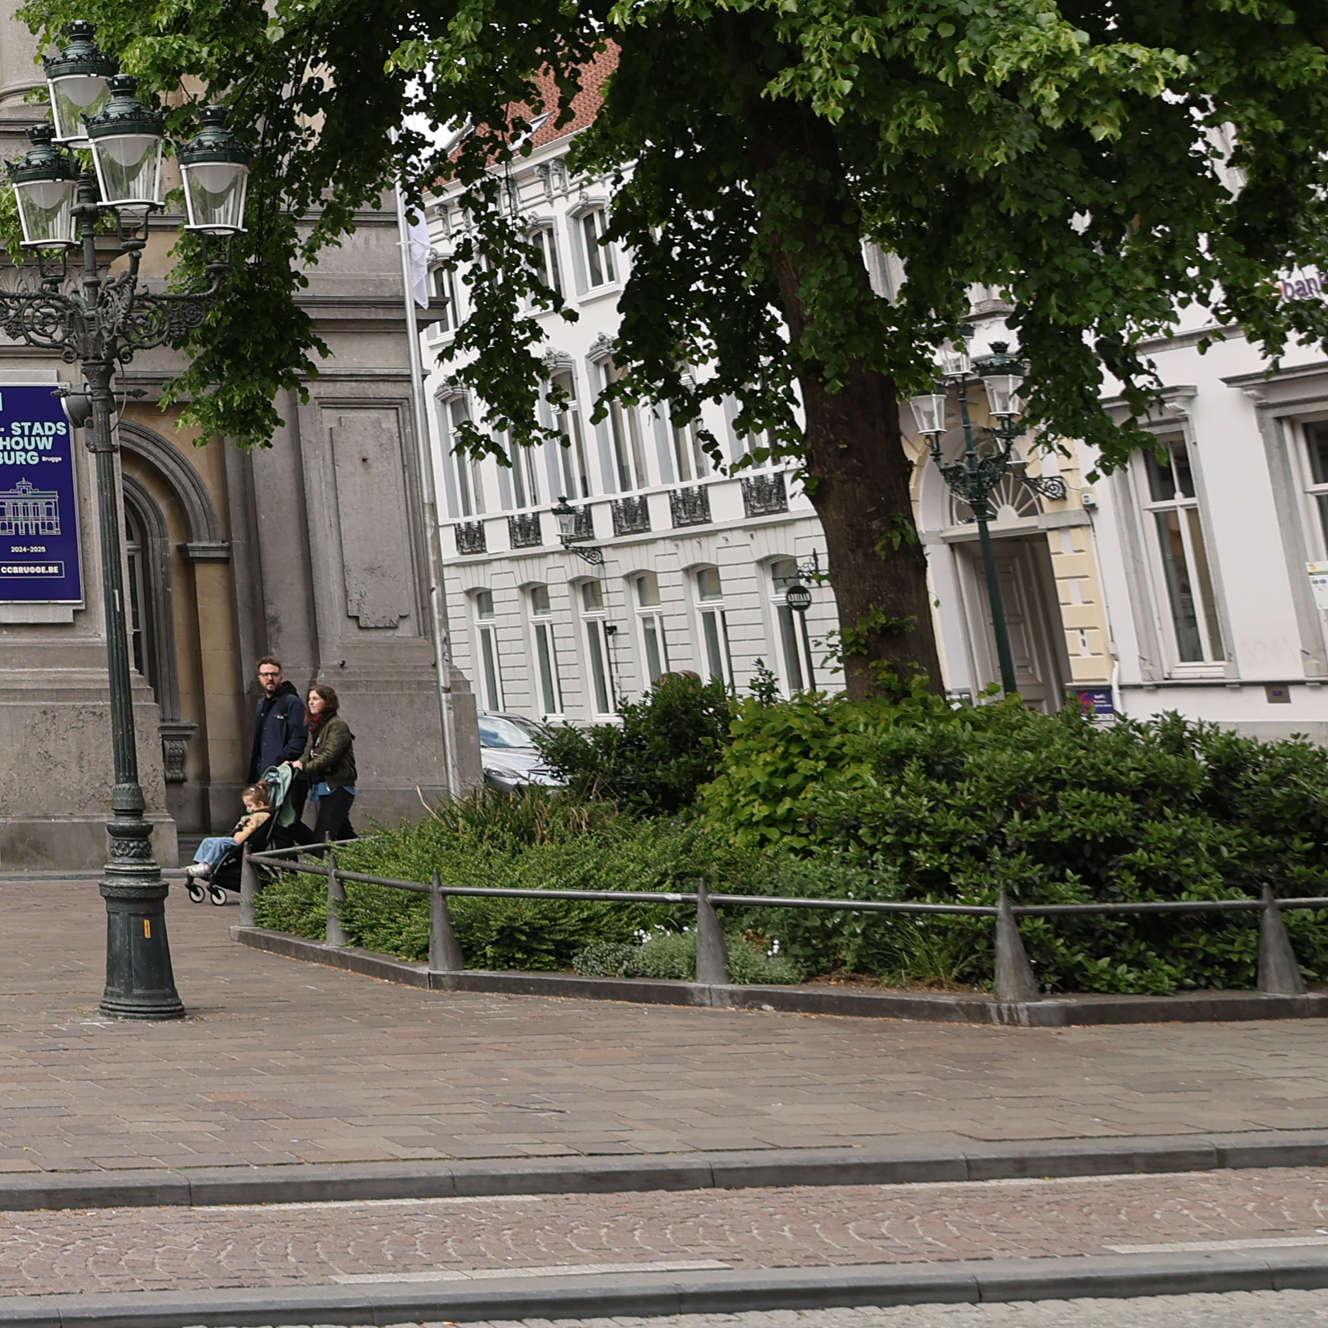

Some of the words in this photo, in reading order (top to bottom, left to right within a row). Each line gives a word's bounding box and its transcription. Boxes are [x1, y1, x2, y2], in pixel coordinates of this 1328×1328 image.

[10, 421, 67, 436] STADS
[10, 545, 46, 553] 2024-2025
[0, 565, 59, 574] CCBRUGGE.BE
